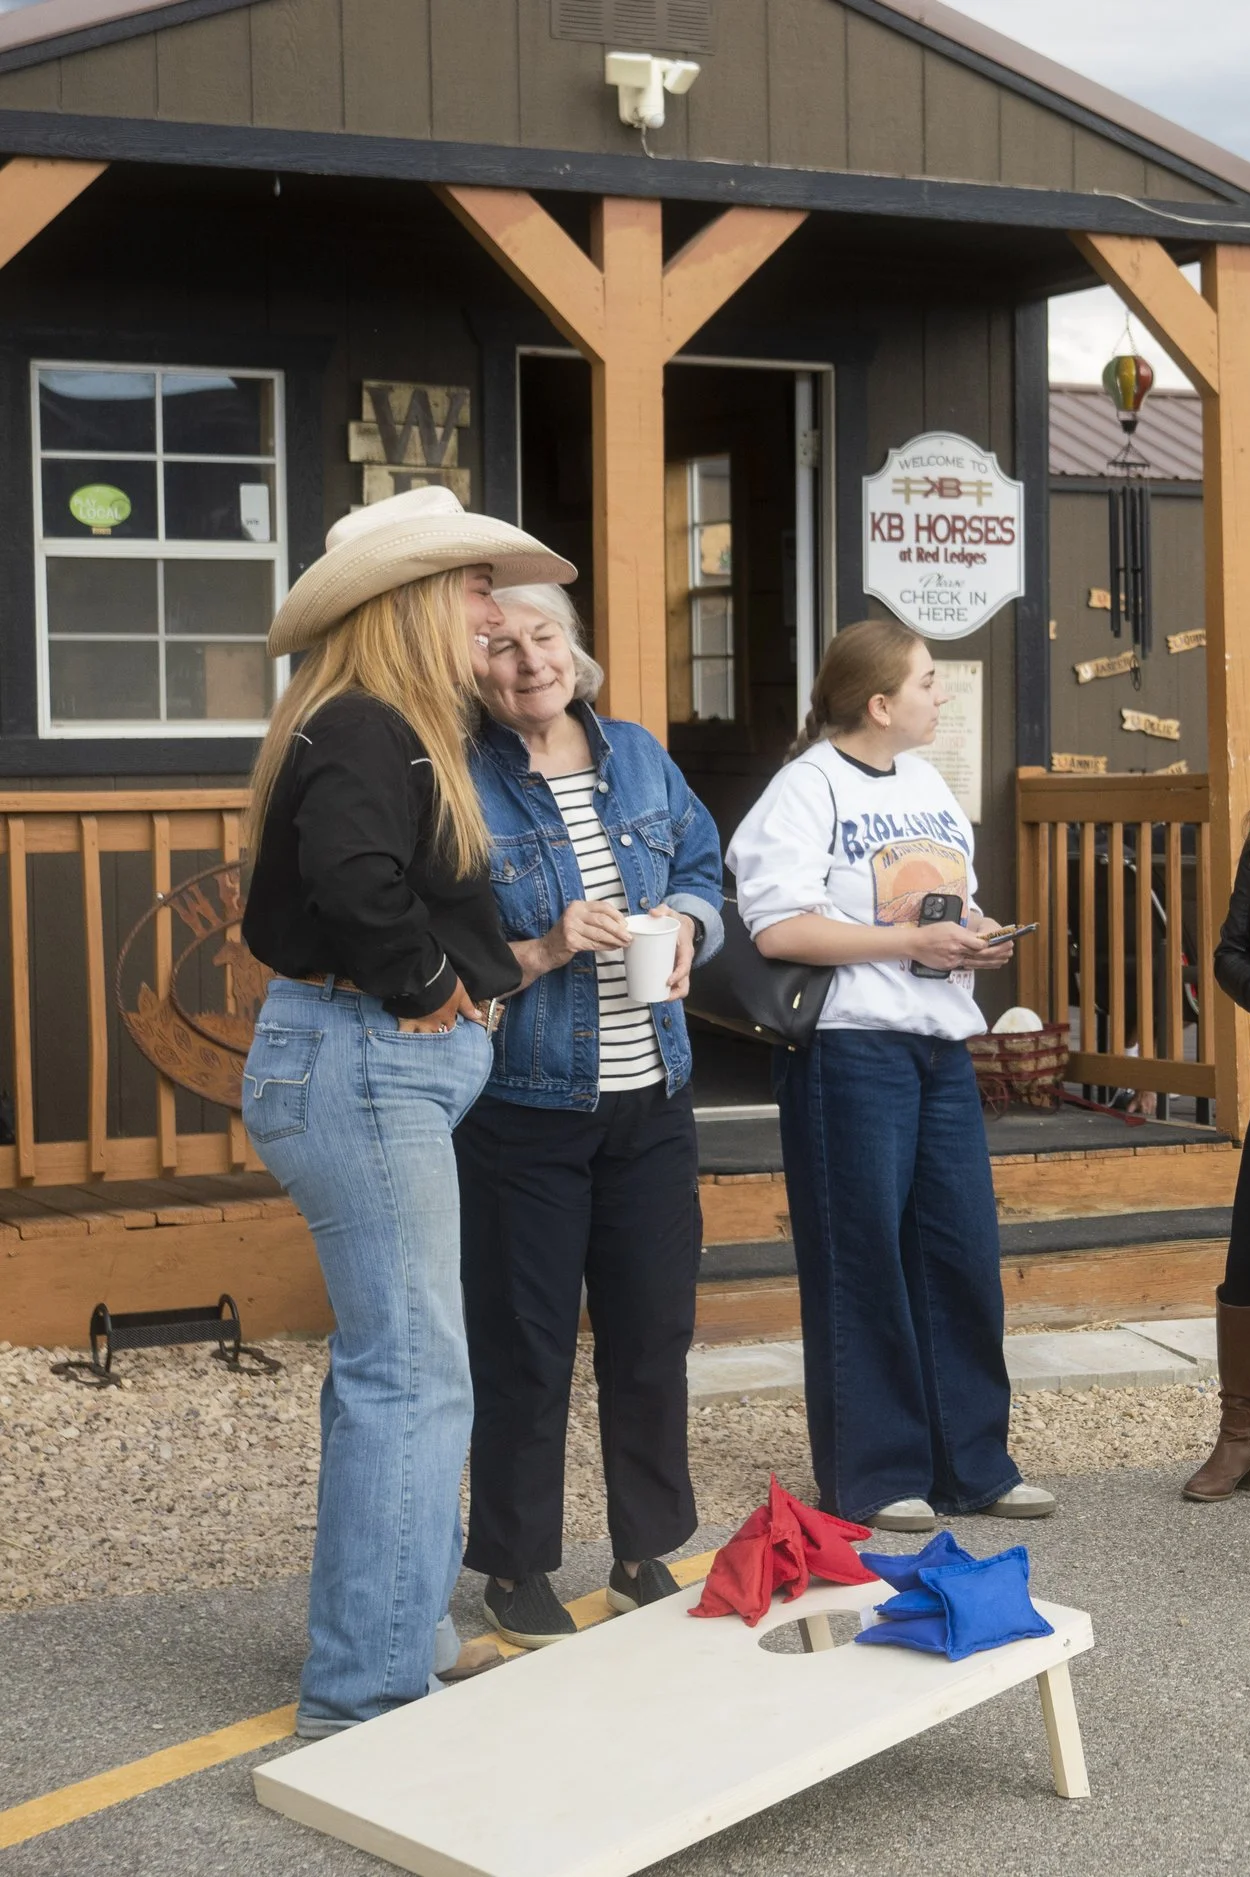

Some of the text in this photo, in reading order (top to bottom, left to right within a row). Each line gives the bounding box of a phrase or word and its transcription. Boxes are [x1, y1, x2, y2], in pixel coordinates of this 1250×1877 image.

[899, 456, 988, 474] WELCOME TO
[79, 506, 122, 521] LOCAL
[870, 512, 1015, 545] KB HORSES
[899, 547, 987, 568] at Red Ledges
[899, 590, 987, 605] CHECK IN
[918, 607, 968, 622] HERE
